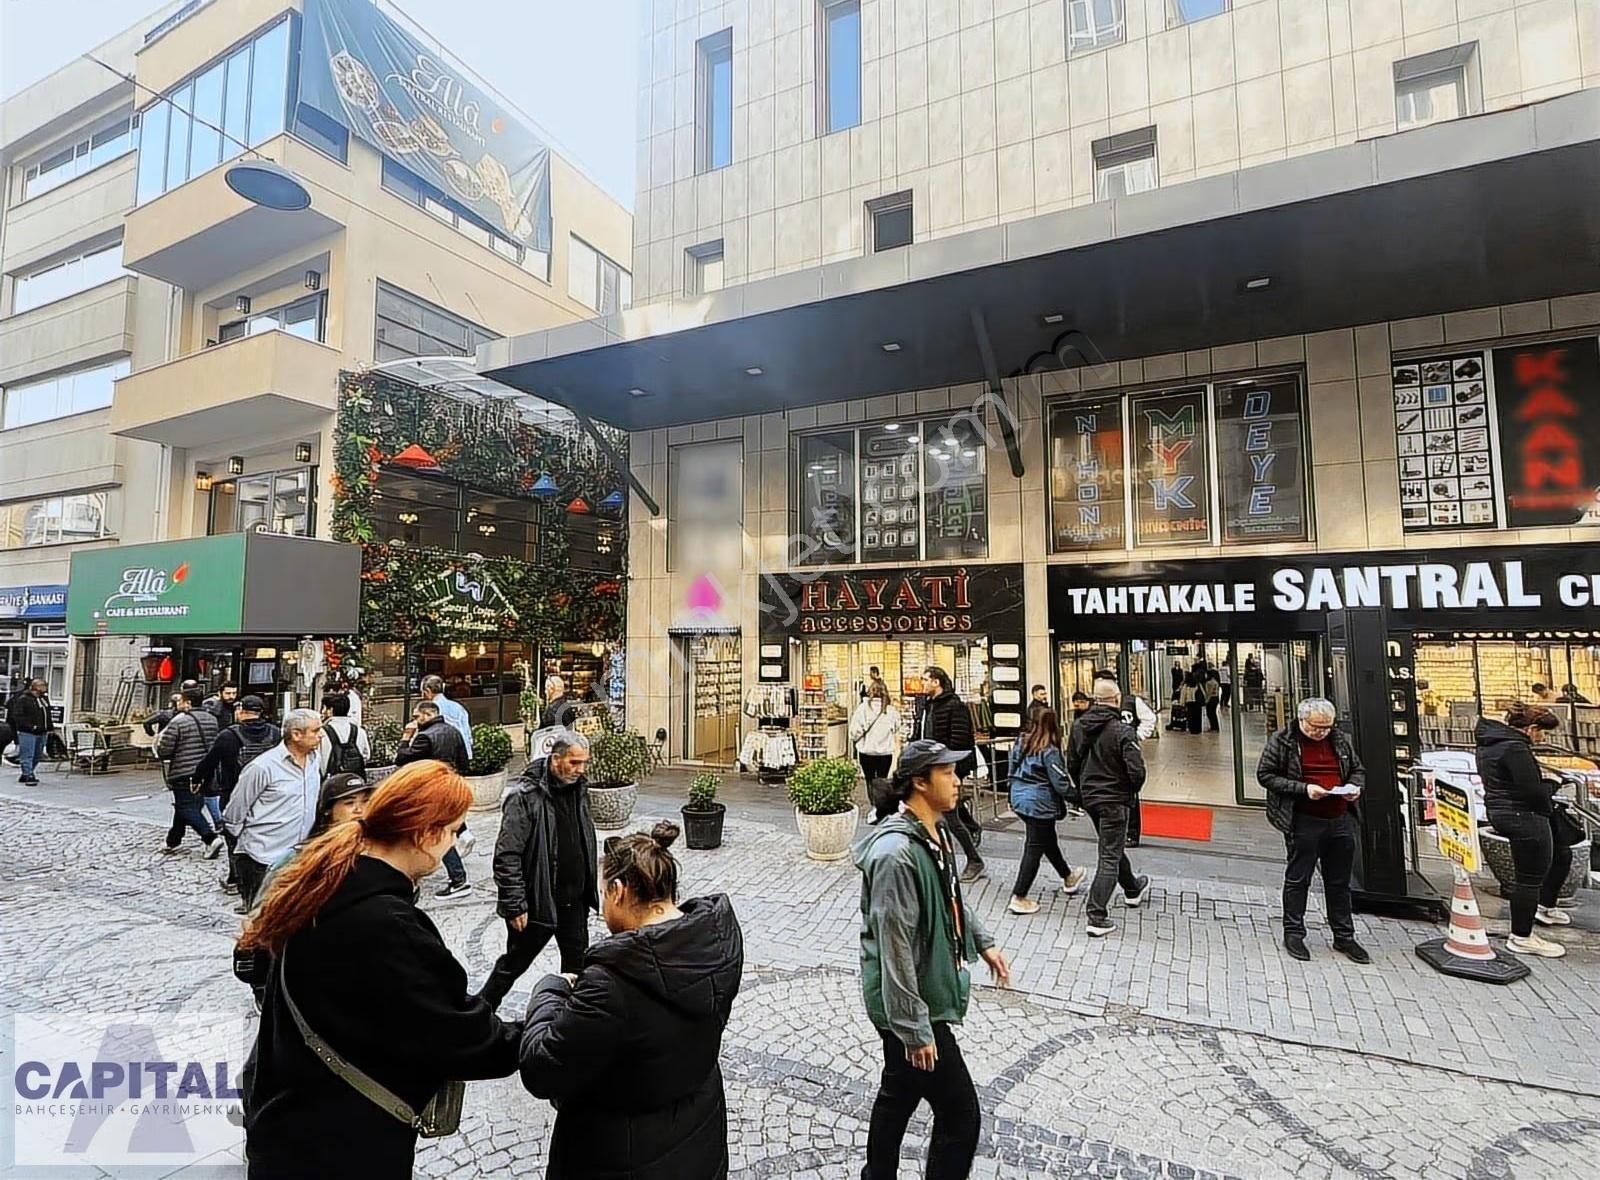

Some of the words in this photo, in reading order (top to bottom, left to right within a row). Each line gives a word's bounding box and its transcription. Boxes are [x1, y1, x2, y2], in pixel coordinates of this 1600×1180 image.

[1143, 404, 1196, 510] MYK
[1243, 391, 1276, 515] DEYE
[134, 605, 190, 617] RESTAURANT
[801, 567, 972, 612] HAYATİ
[1067, 583, 1256, 616] TAHTAKALE
[1271, 560, 1542, 612] SANTRAL
[801, 609, 973, 633] accessories
